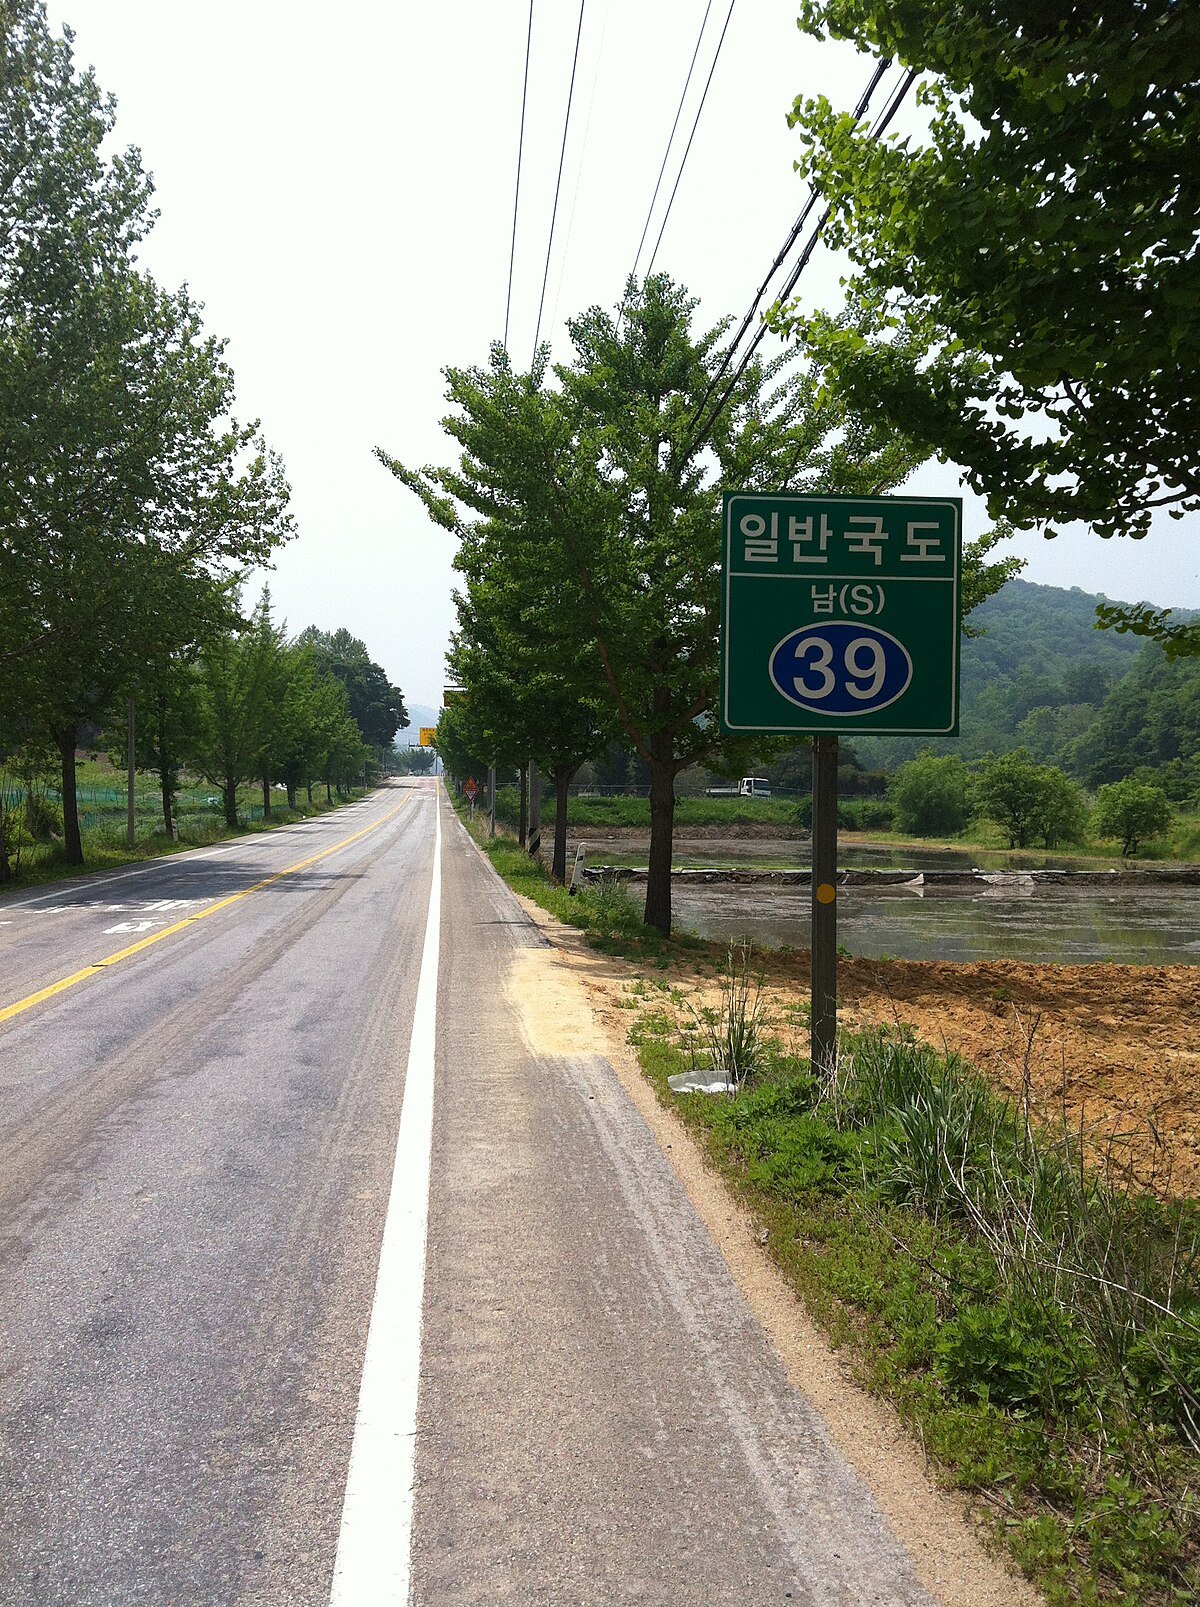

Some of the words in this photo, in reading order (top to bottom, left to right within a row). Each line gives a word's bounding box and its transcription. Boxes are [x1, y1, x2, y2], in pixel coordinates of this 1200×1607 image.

[739, 512, 946, 565] 일반국도
[811, 584, 886, 615] 남(S)
[793, 636, 887, 700] 39
